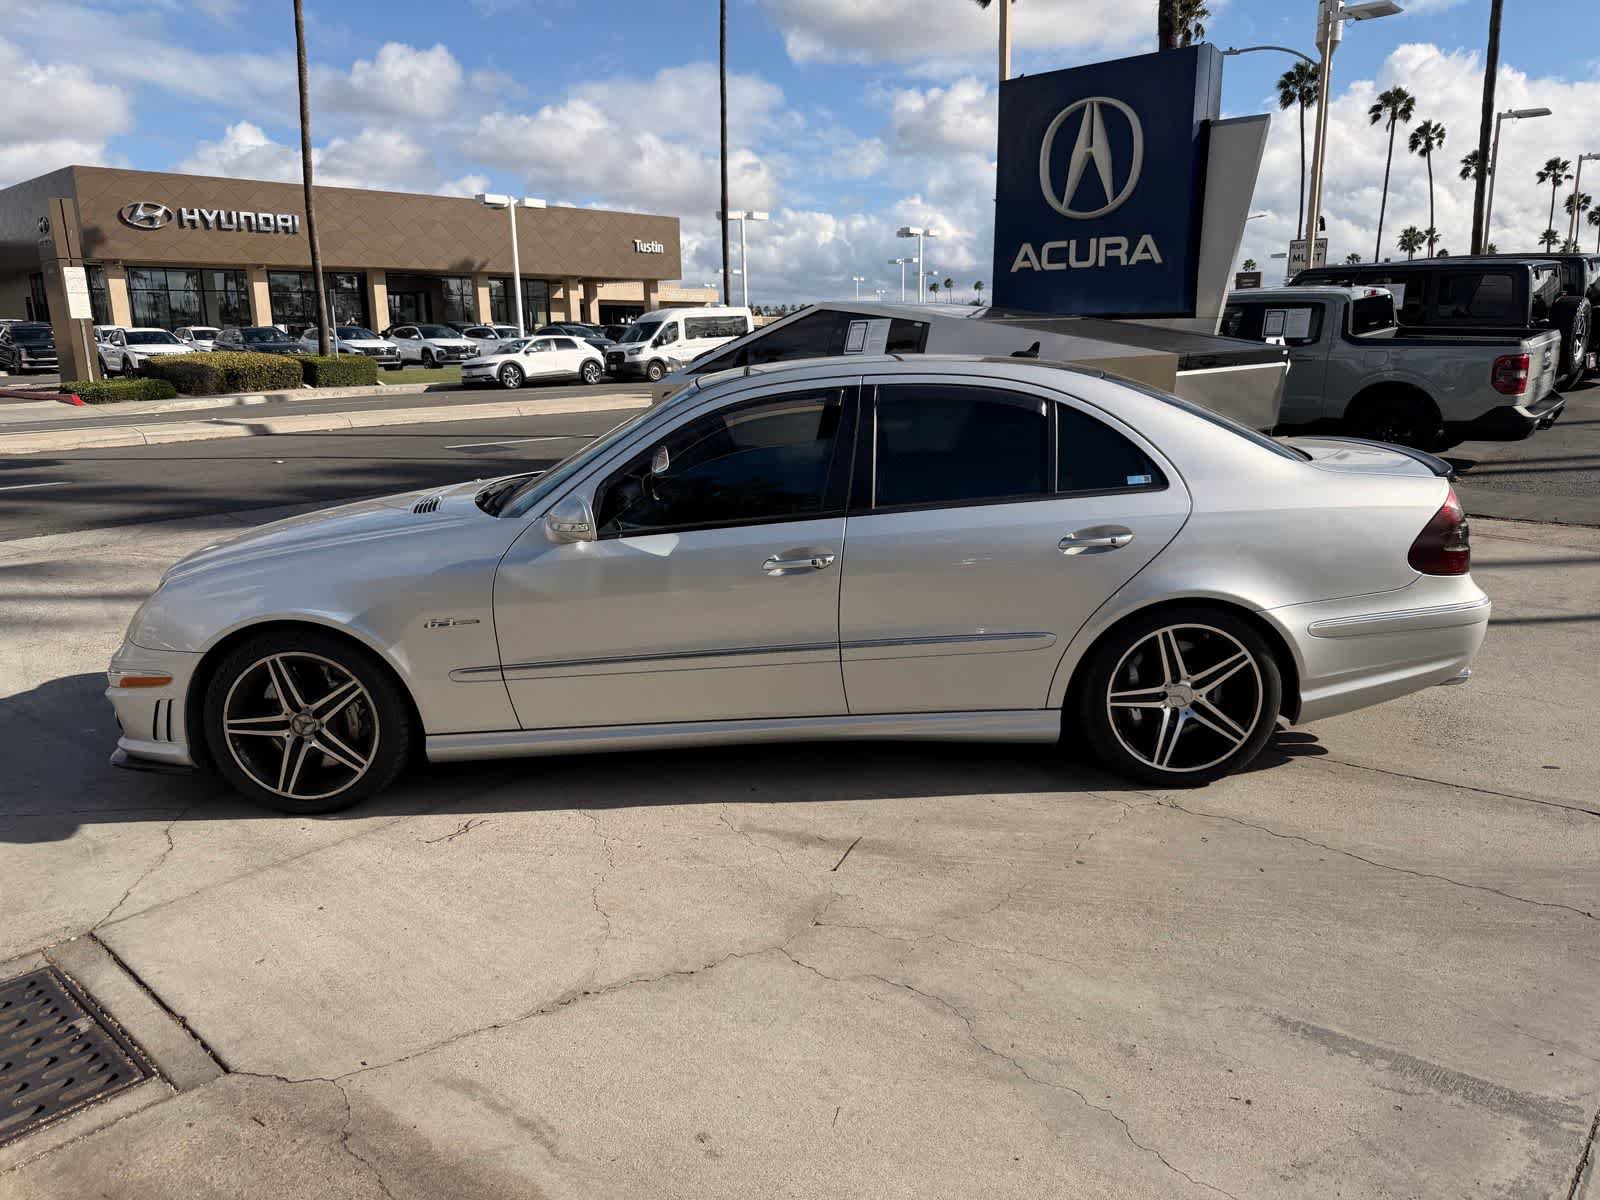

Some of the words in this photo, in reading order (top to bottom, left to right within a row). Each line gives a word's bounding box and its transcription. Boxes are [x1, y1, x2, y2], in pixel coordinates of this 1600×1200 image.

[179, 207, 299, 234] HYUNDAI
[634, 239, 664, 254] Tustin
[1010, 234, 1162, 272] ACURA
[1293, 252, 1322, 262] MUT
